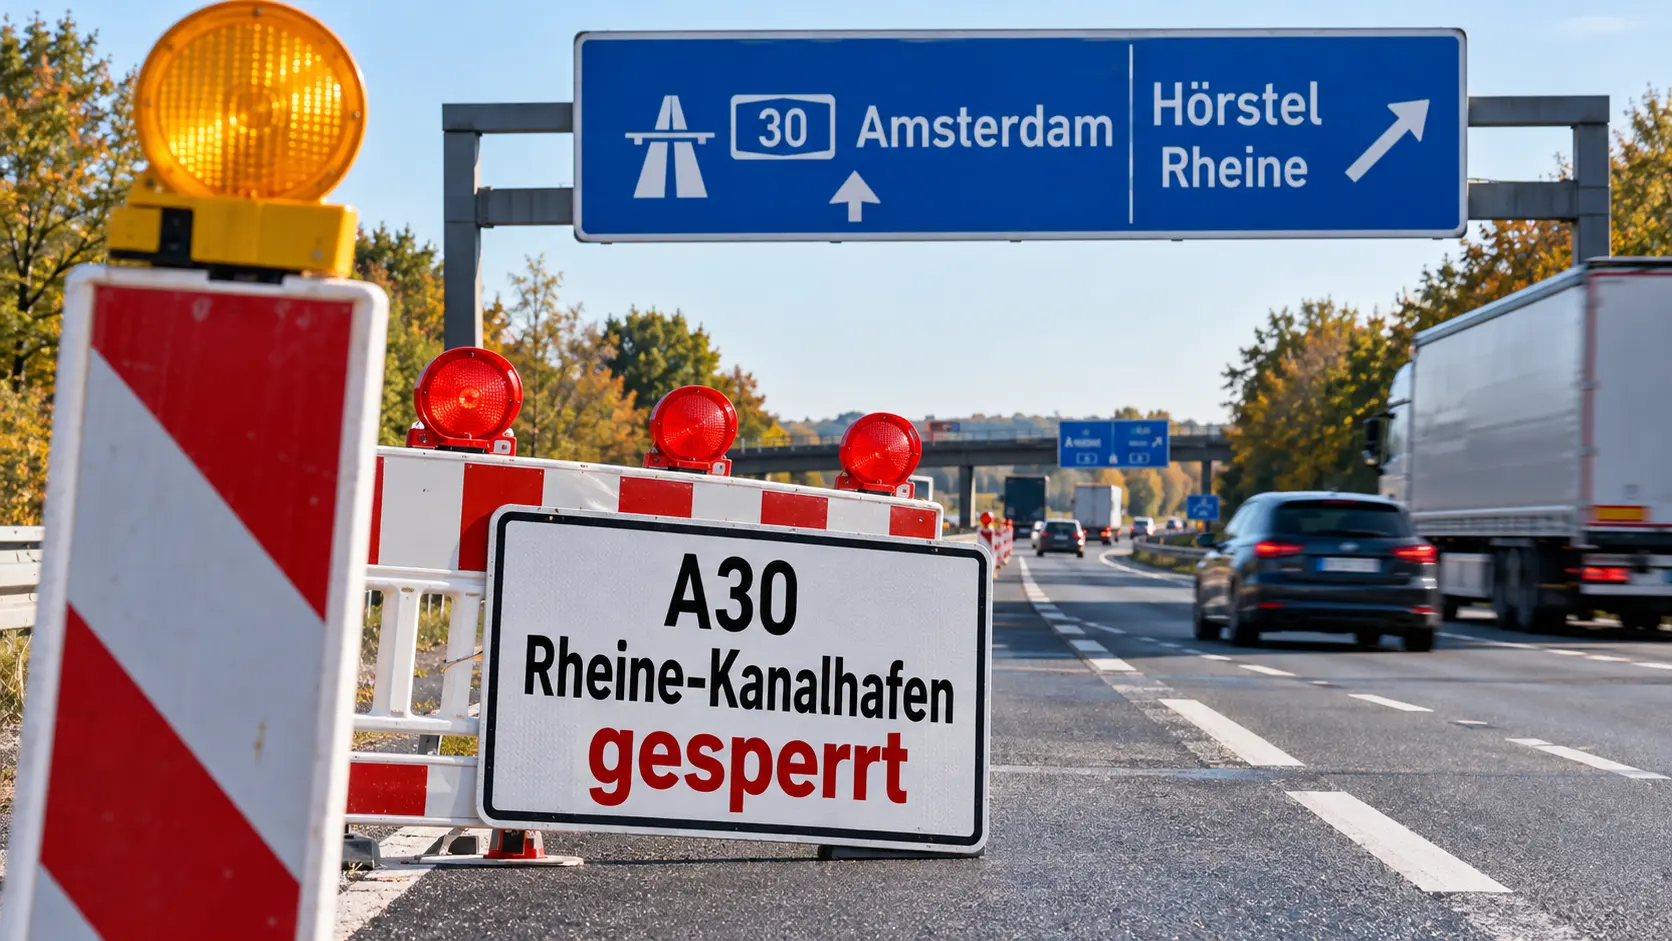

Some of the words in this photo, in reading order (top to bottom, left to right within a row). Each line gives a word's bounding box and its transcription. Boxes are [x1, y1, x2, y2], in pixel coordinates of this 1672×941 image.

[758, 107, 807, 148] 30
[856, 104, 1113, 148] Amsterdam
[1153, 80, 1322, 127] Hörstel
[1161, 145, 1308, 188] Rheine
[664, 553, 798, 636] A30
[524, 634, 954, 724] Rheine-Kanalhafen
[588, 727, 908, 813] gesperrt
